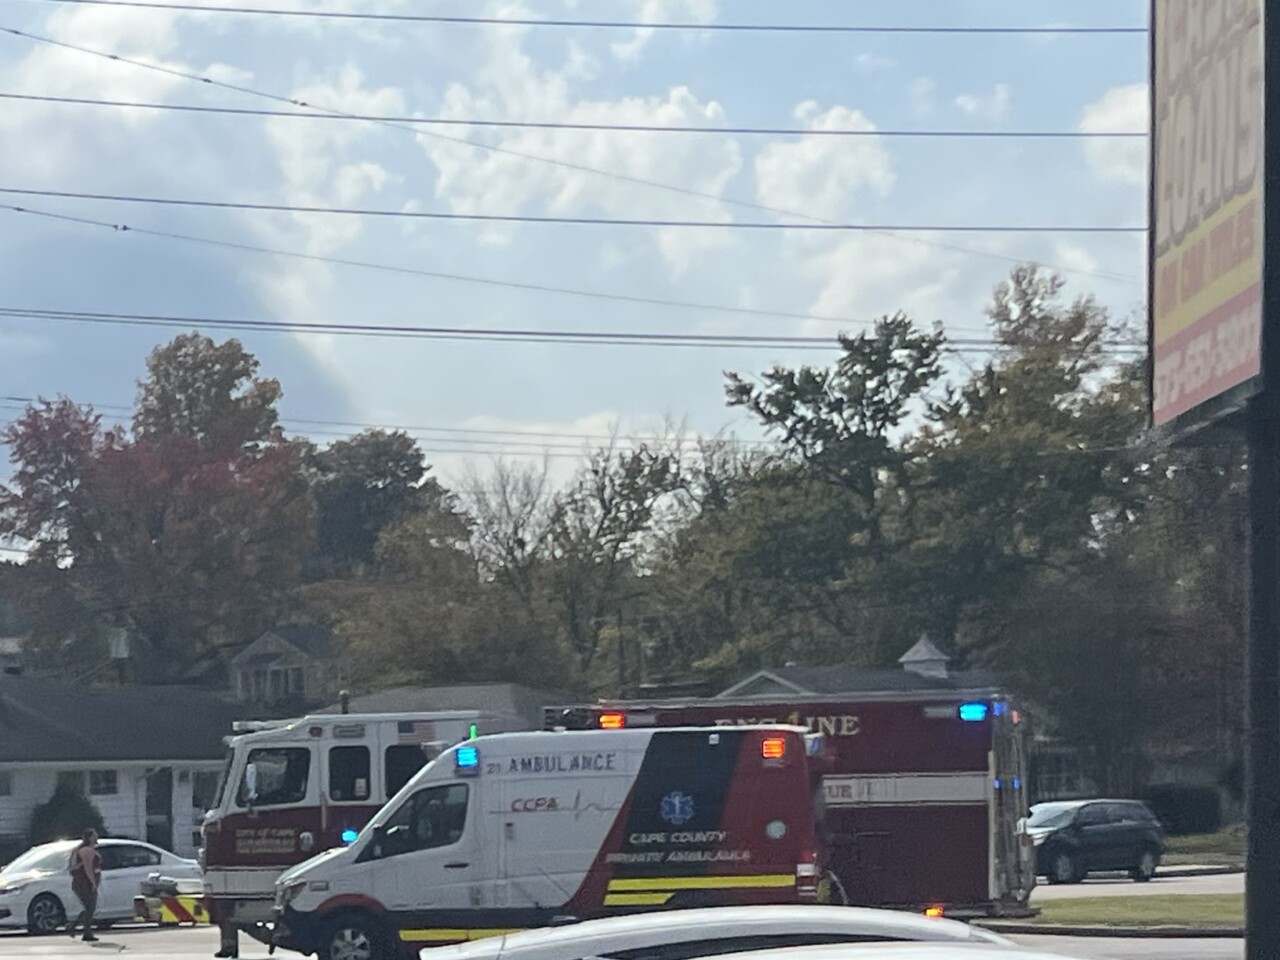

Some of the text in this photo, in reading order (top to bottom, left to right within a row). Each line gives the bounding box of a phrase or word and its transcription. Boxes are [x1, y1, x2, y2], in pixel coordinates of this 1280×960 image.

[508, 752, 617, 774] AMBULANCE
[511, 797, 559, 812] CCPA
[629, 830, 727, 844] CAPE COUNTY
